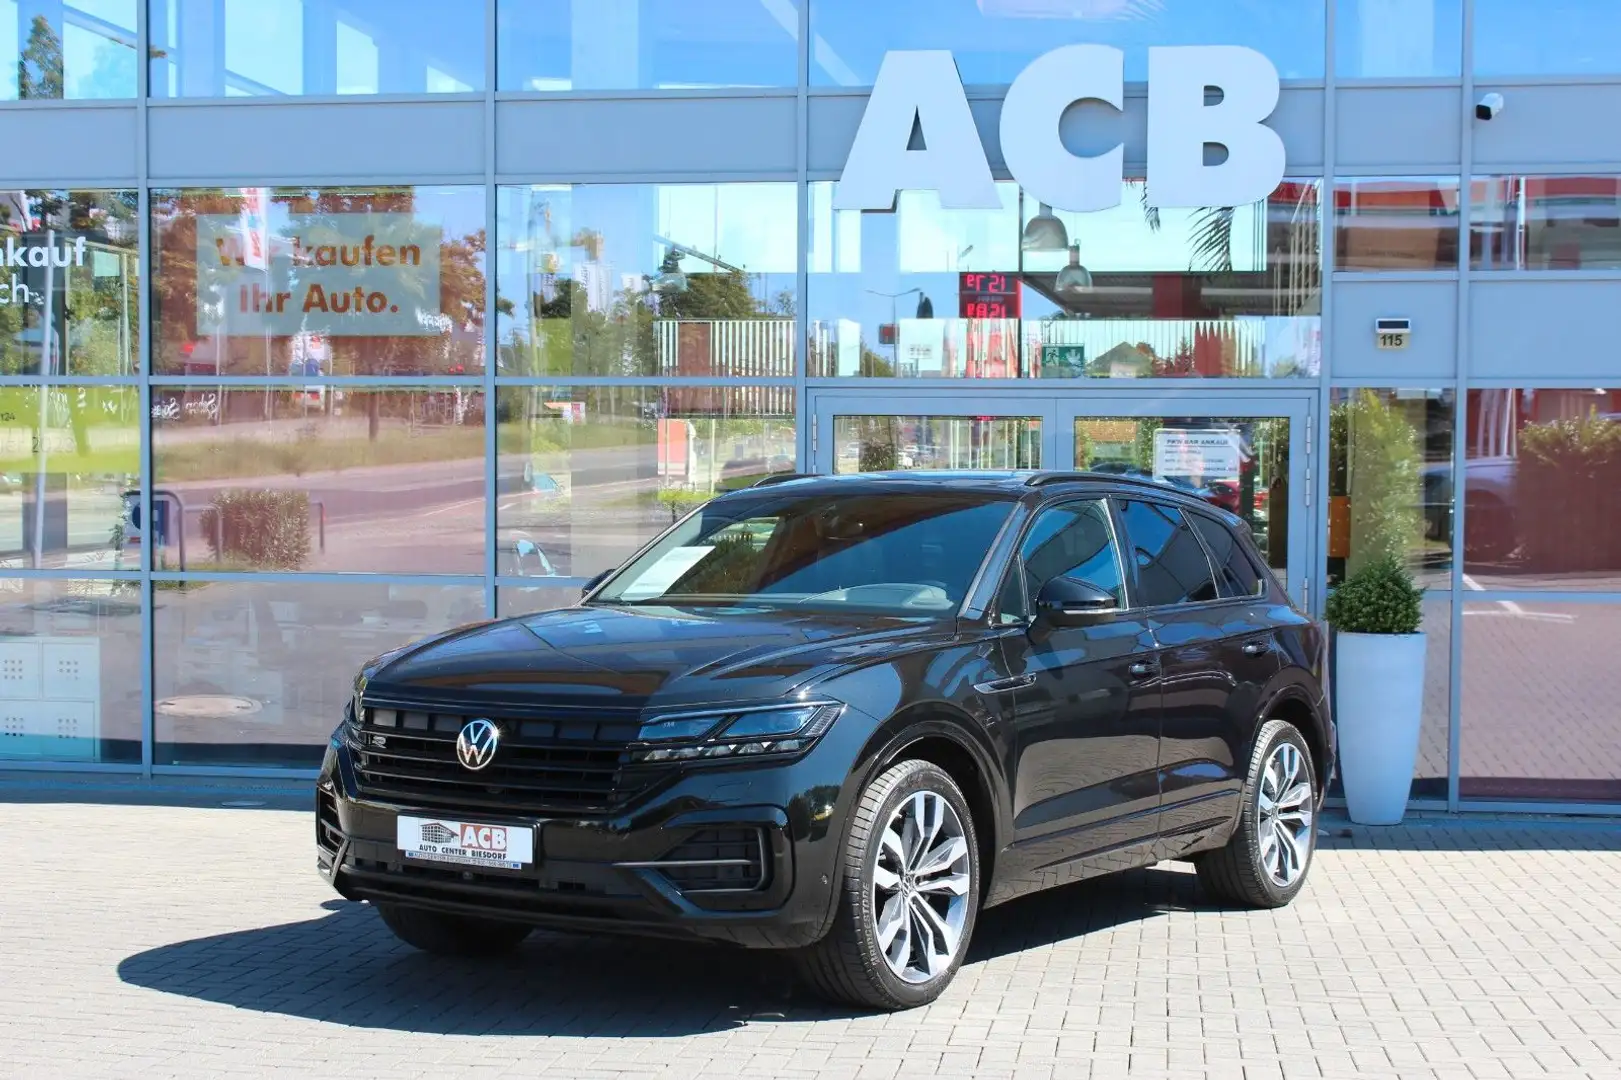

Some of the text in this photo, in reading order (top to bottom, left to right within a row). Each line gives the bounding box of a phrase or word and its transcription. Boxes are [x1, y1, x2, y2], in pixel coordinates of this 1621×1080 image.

[832, 44, 1286, 213] ACB
[0, 236, 86, 267] kauf
[216, 234, 420, 266] Wr kaufen
[240, 283, 398, 313] Ihr Auto.
[1380, 334, 1403, 347] 115
[457, 718, 497, 770] VW
[419, 844, 507, 860] AUTO CENTER BIESDORF
[461, 825, 507, 850] ACB
